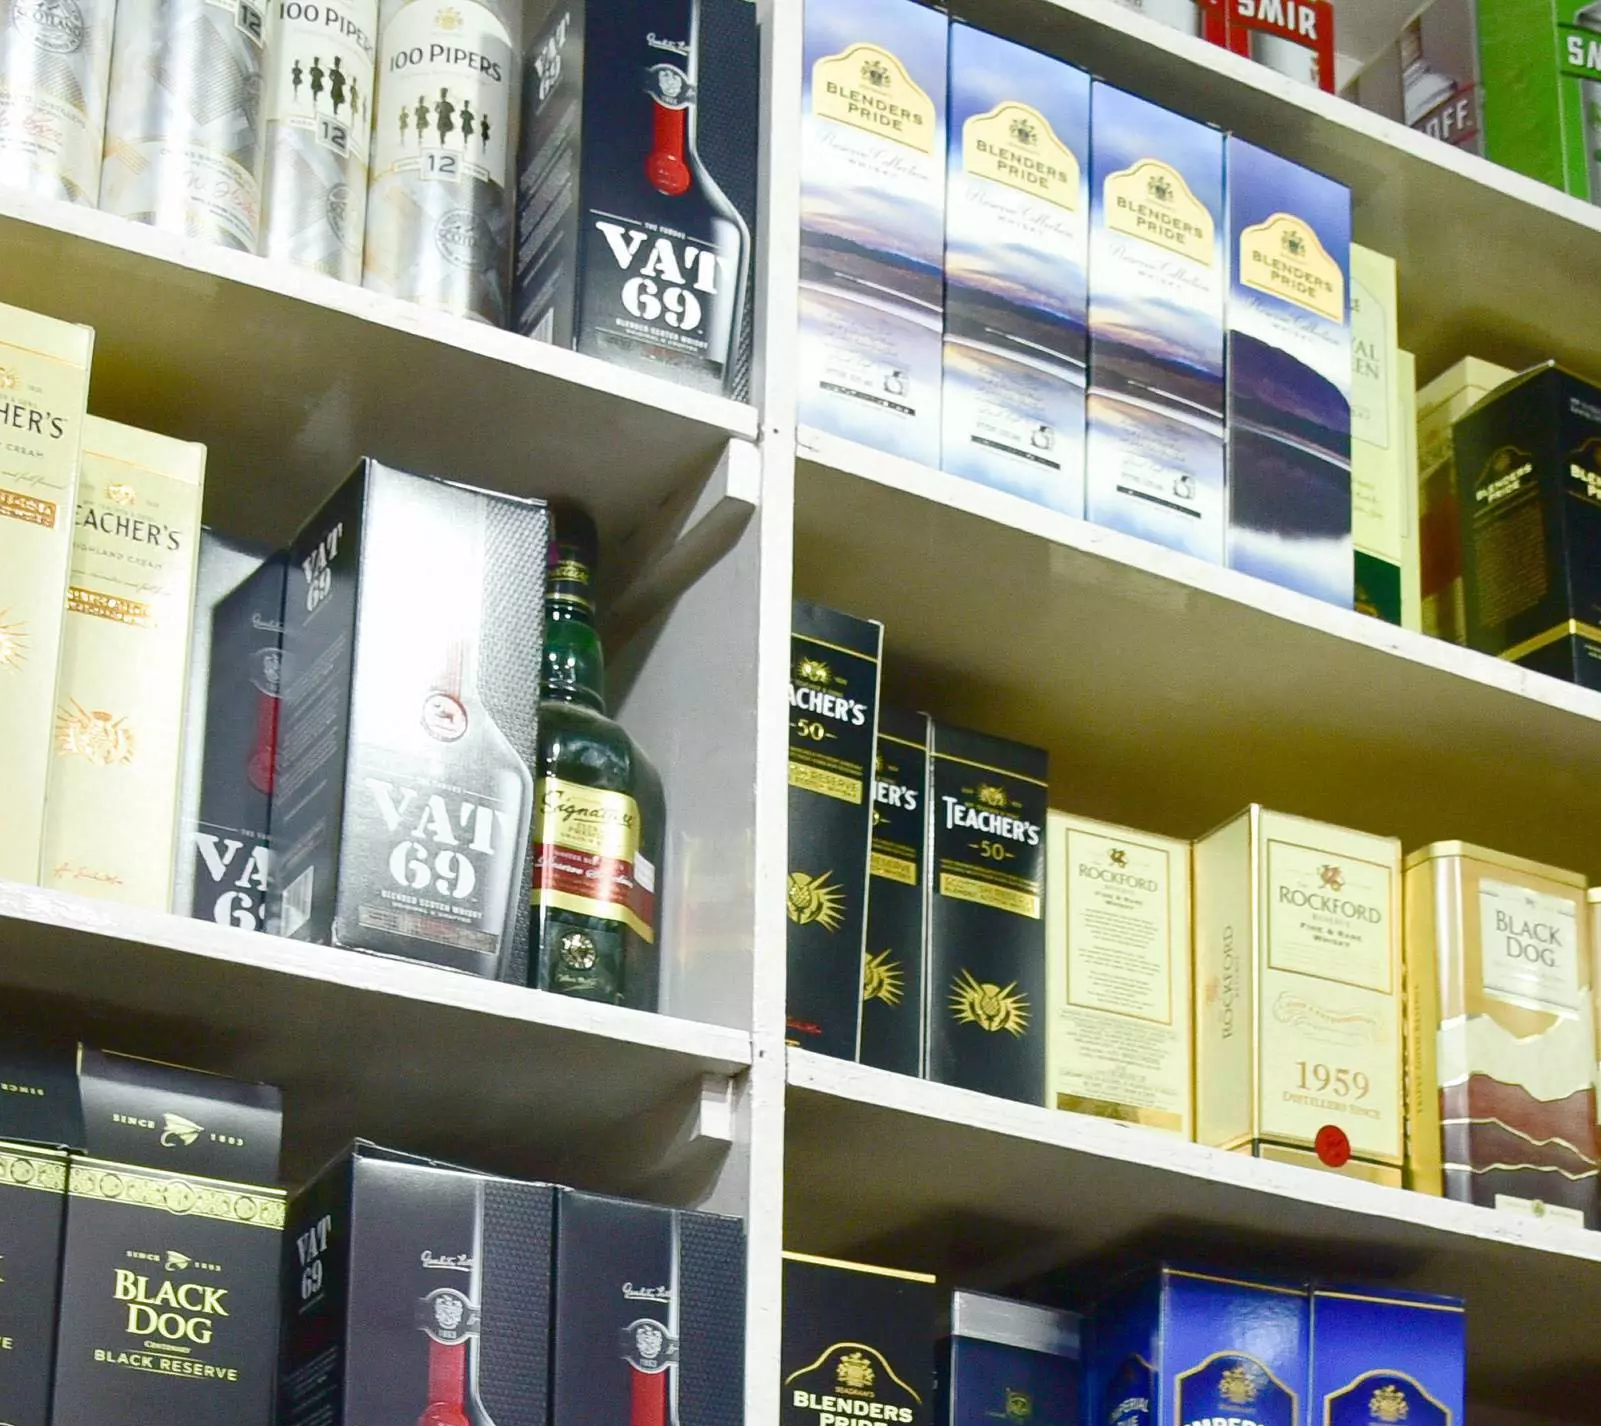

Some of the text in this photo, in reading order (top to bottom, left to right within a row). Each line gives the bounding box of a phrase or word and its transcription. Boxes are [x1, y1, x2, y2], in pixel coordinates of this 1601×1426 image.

[280, 3, 319, 23] 100
[390, 44, 502, 82] 100 PIPERS
[826, 81, 924, 126] BLENDERS
[848, 103, 903, 132] PRIDE
[322, 121, 347, 149] 12
[428, 154, 457, 174] 12
[975, 139, 1069, 184] BLENDERS
[997, 159, 1050, 190] PRIDE
[1116, 195, 1205, 240] BLENDERS
[1136, 216, 1186, 246] PRIDE
[595, 220, 725, 295] VAT
[1251, 250, 1334, 294] BLENDERS
[621, 276, 702, 332] 69
[1270, 269, 1317, 299] PRIDE
[6, 442, 44, 459] CREAM
[301, 522, 343, 583] VAT
[307, 568, 331, 611] 69
[365, 777, 501, 855] VAT
[942, 795, 1040, 846] TEACHER'S
[390, 841, 475, 900] 69
[1079, 863, 1158, 893] ROCKFORD
[382, 889, 483, 920] BLENDED SCOTCH WHISKY
[1279, 885, 1382, 925] ROCKFORD
[1495, 909, 1563, 947] BLACK
[1505, 934, 1556, 969] DOG
[1221, 924, 1235, 1040] ROCKFORD
[1295, 1061, 1370, 1101] 1959
[113, 1113, 156, 1129] SINCE
[127, 1250, 161, 1262] SINCE
[297, 1215, 331, 1266] VAT
[113, 1268, 229, 1318] BLACK
[302, 1259, 322, 1299] 69
[126, 1303, 213, 1345] DOG
[93, 1348, 238, 1382] BLACK RESERVE
[793, 1389, 914, 1424] BLENDERS
